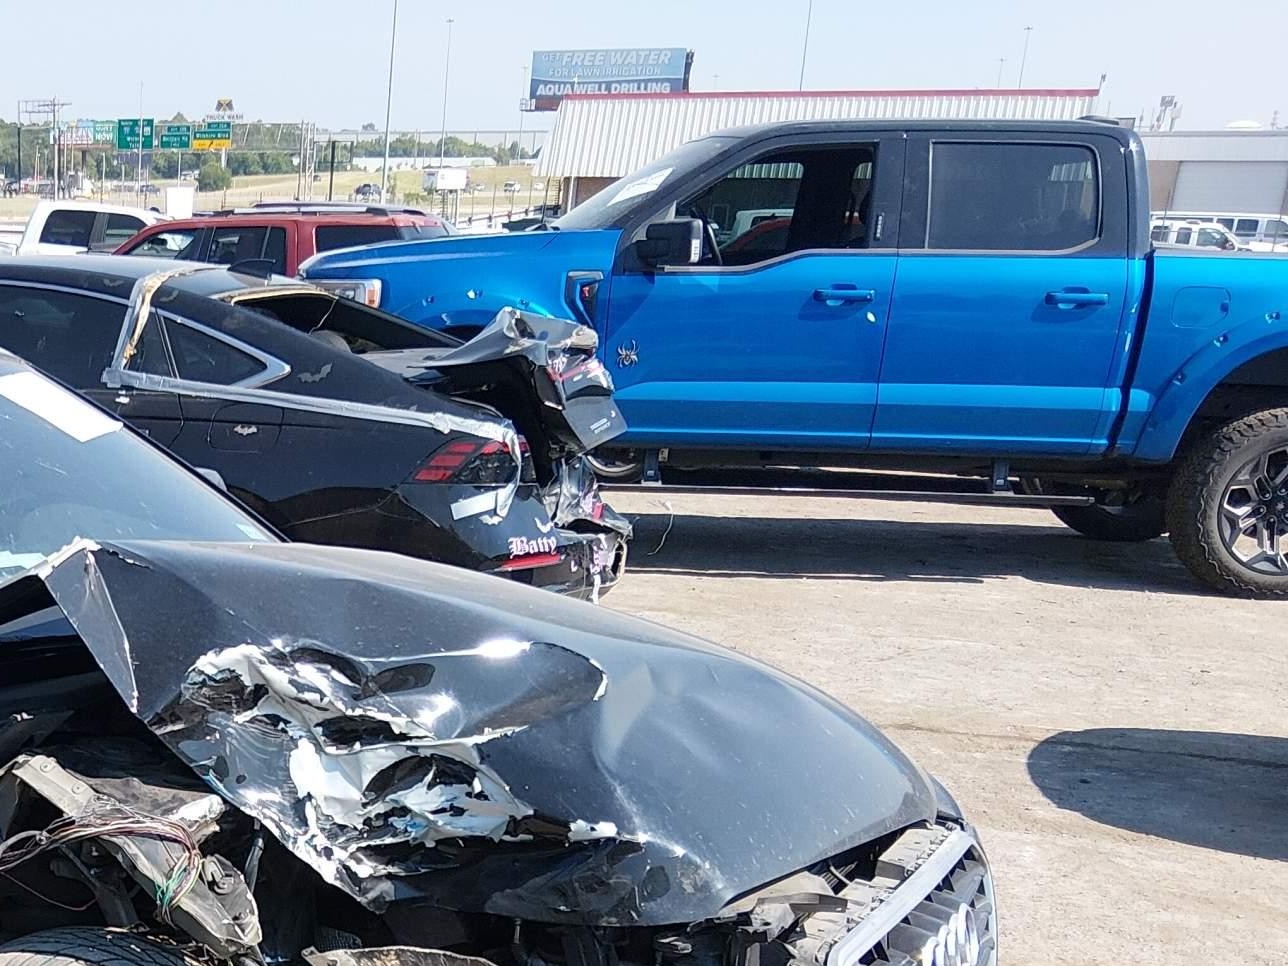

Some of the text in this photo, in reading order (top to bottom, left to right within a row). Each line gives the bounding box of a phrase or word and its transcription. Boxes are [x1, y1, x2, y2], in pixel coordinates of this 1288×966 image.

[542, 51, 671, 66] GET FREE WATER
[548, 65, 661, 77] FOR LAWN IRRIGATION
[536, 82, 671, 95] AQUA WELL DRILLING
[508, 535, 558, 559] Batty
